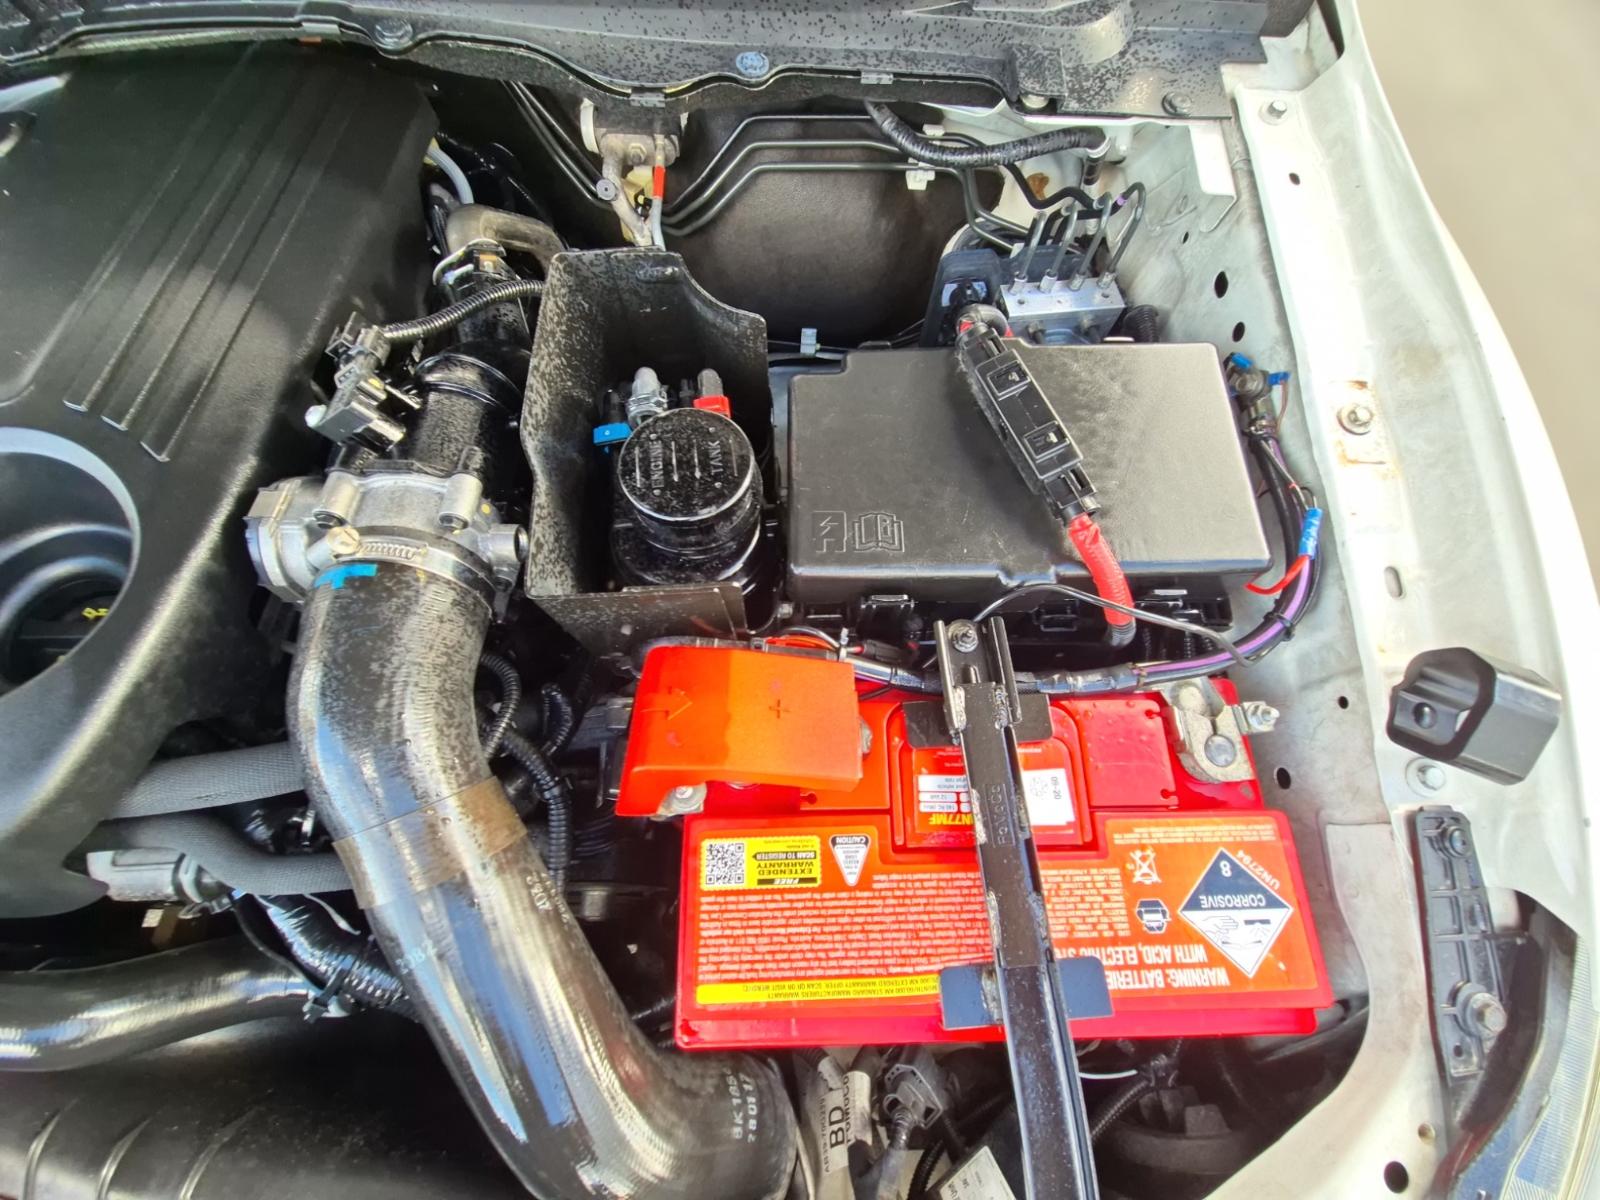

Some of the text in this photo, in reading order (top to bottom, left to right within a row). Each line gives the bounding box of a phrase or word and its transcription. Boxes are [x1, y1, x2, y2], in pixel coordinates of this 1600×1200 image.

[649, 440, 664, 488] ENGINE
[708, 440, 723, 476] TANK
[836, 836, 866, 844] CAUTION
[756, 861, 814, 869] WARRANTY
[758, 868, 812, 876] EXTENDED
[1219, 860, 1232, 878] 8
[1236, 849, 1280, 890] UN2794
[1198, 894, 1266, 908] CORROSIVE
[1138, 942, 1172, 964] ACID,
[1174, 944, 1207, 963] WITH
[1165, 967, 1230, 989] WARNING:
[828, 1106, 845, 1149] BD
